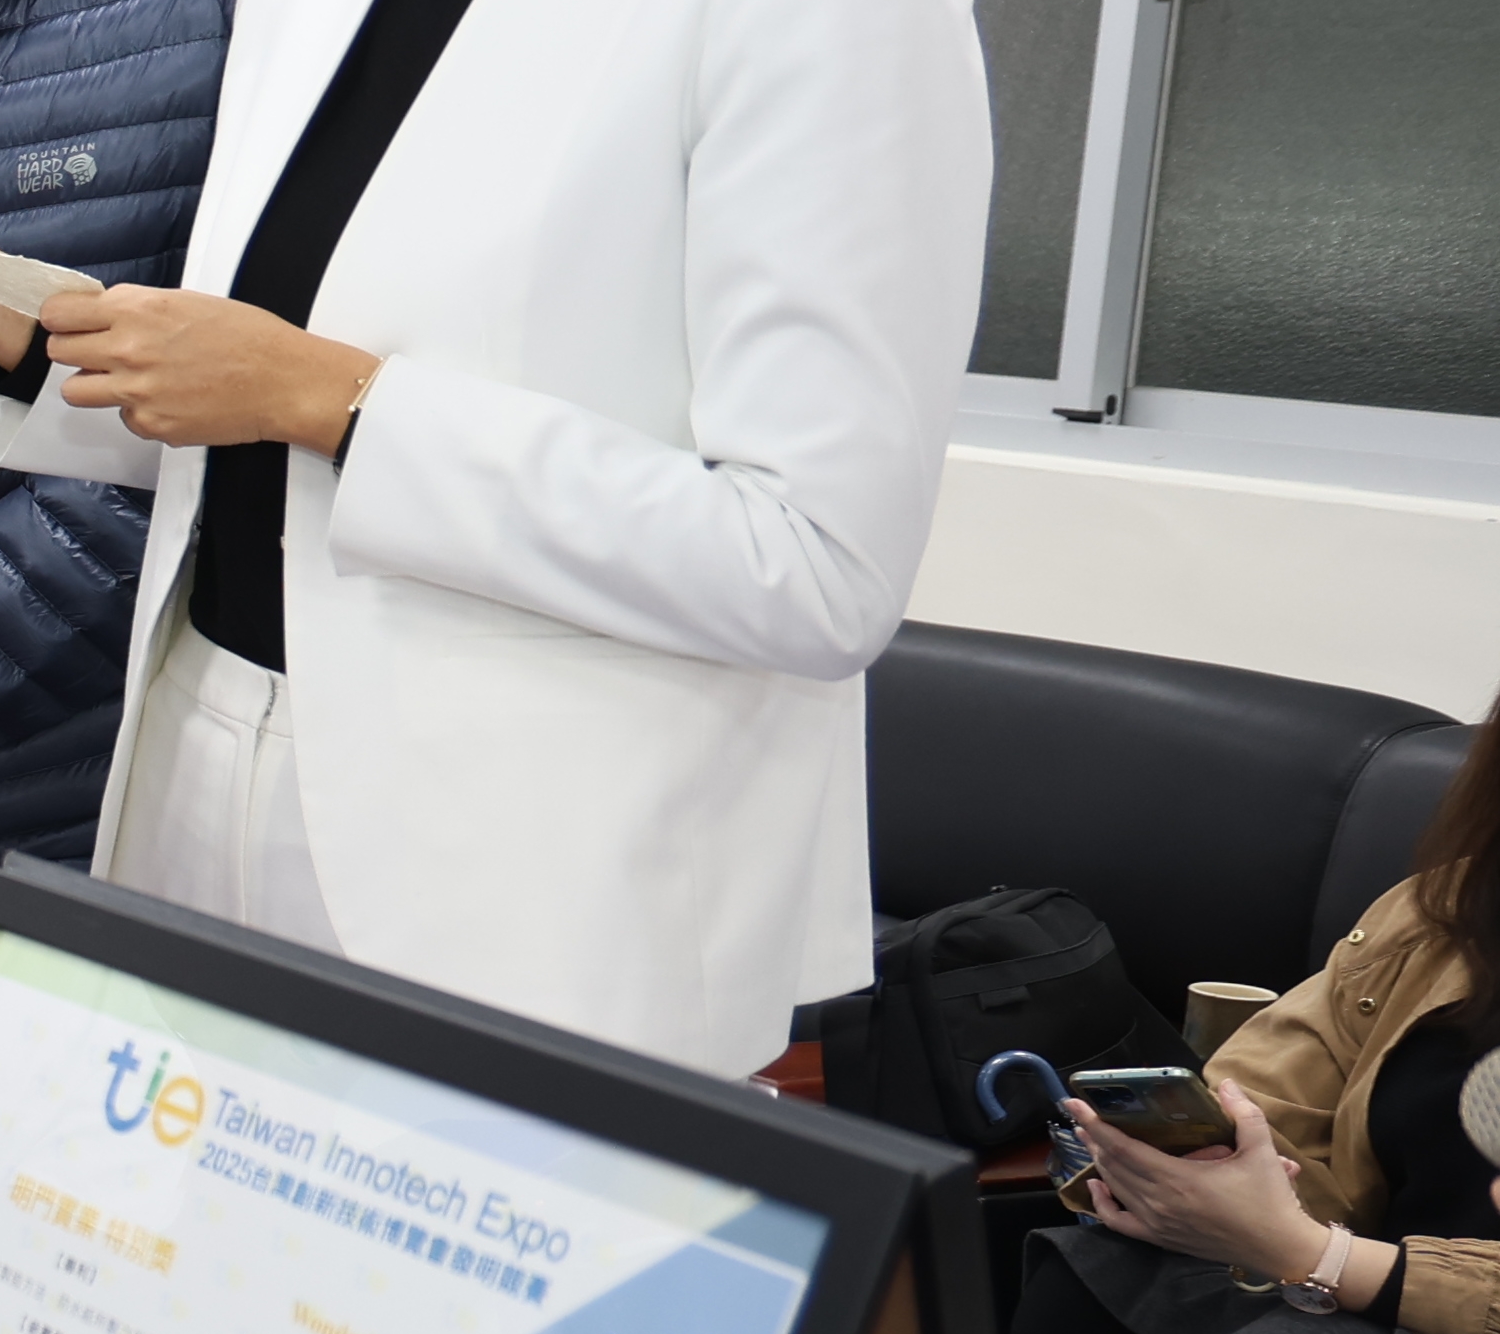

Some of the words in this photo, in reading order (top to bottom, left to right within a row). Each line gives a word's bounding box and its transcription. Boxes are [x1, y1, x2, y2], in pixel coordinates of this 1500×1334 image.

[18, 142, 96, 161] MOUNTAIN
[17, 157, 63, 179] HARD
[17, 172, 64, 195] WEAR
[207, 1086, 319, 1164] Taiwan
[322, 1131, 473, 1224] Innotech
[470, 1189, 579, 1273] Expo
